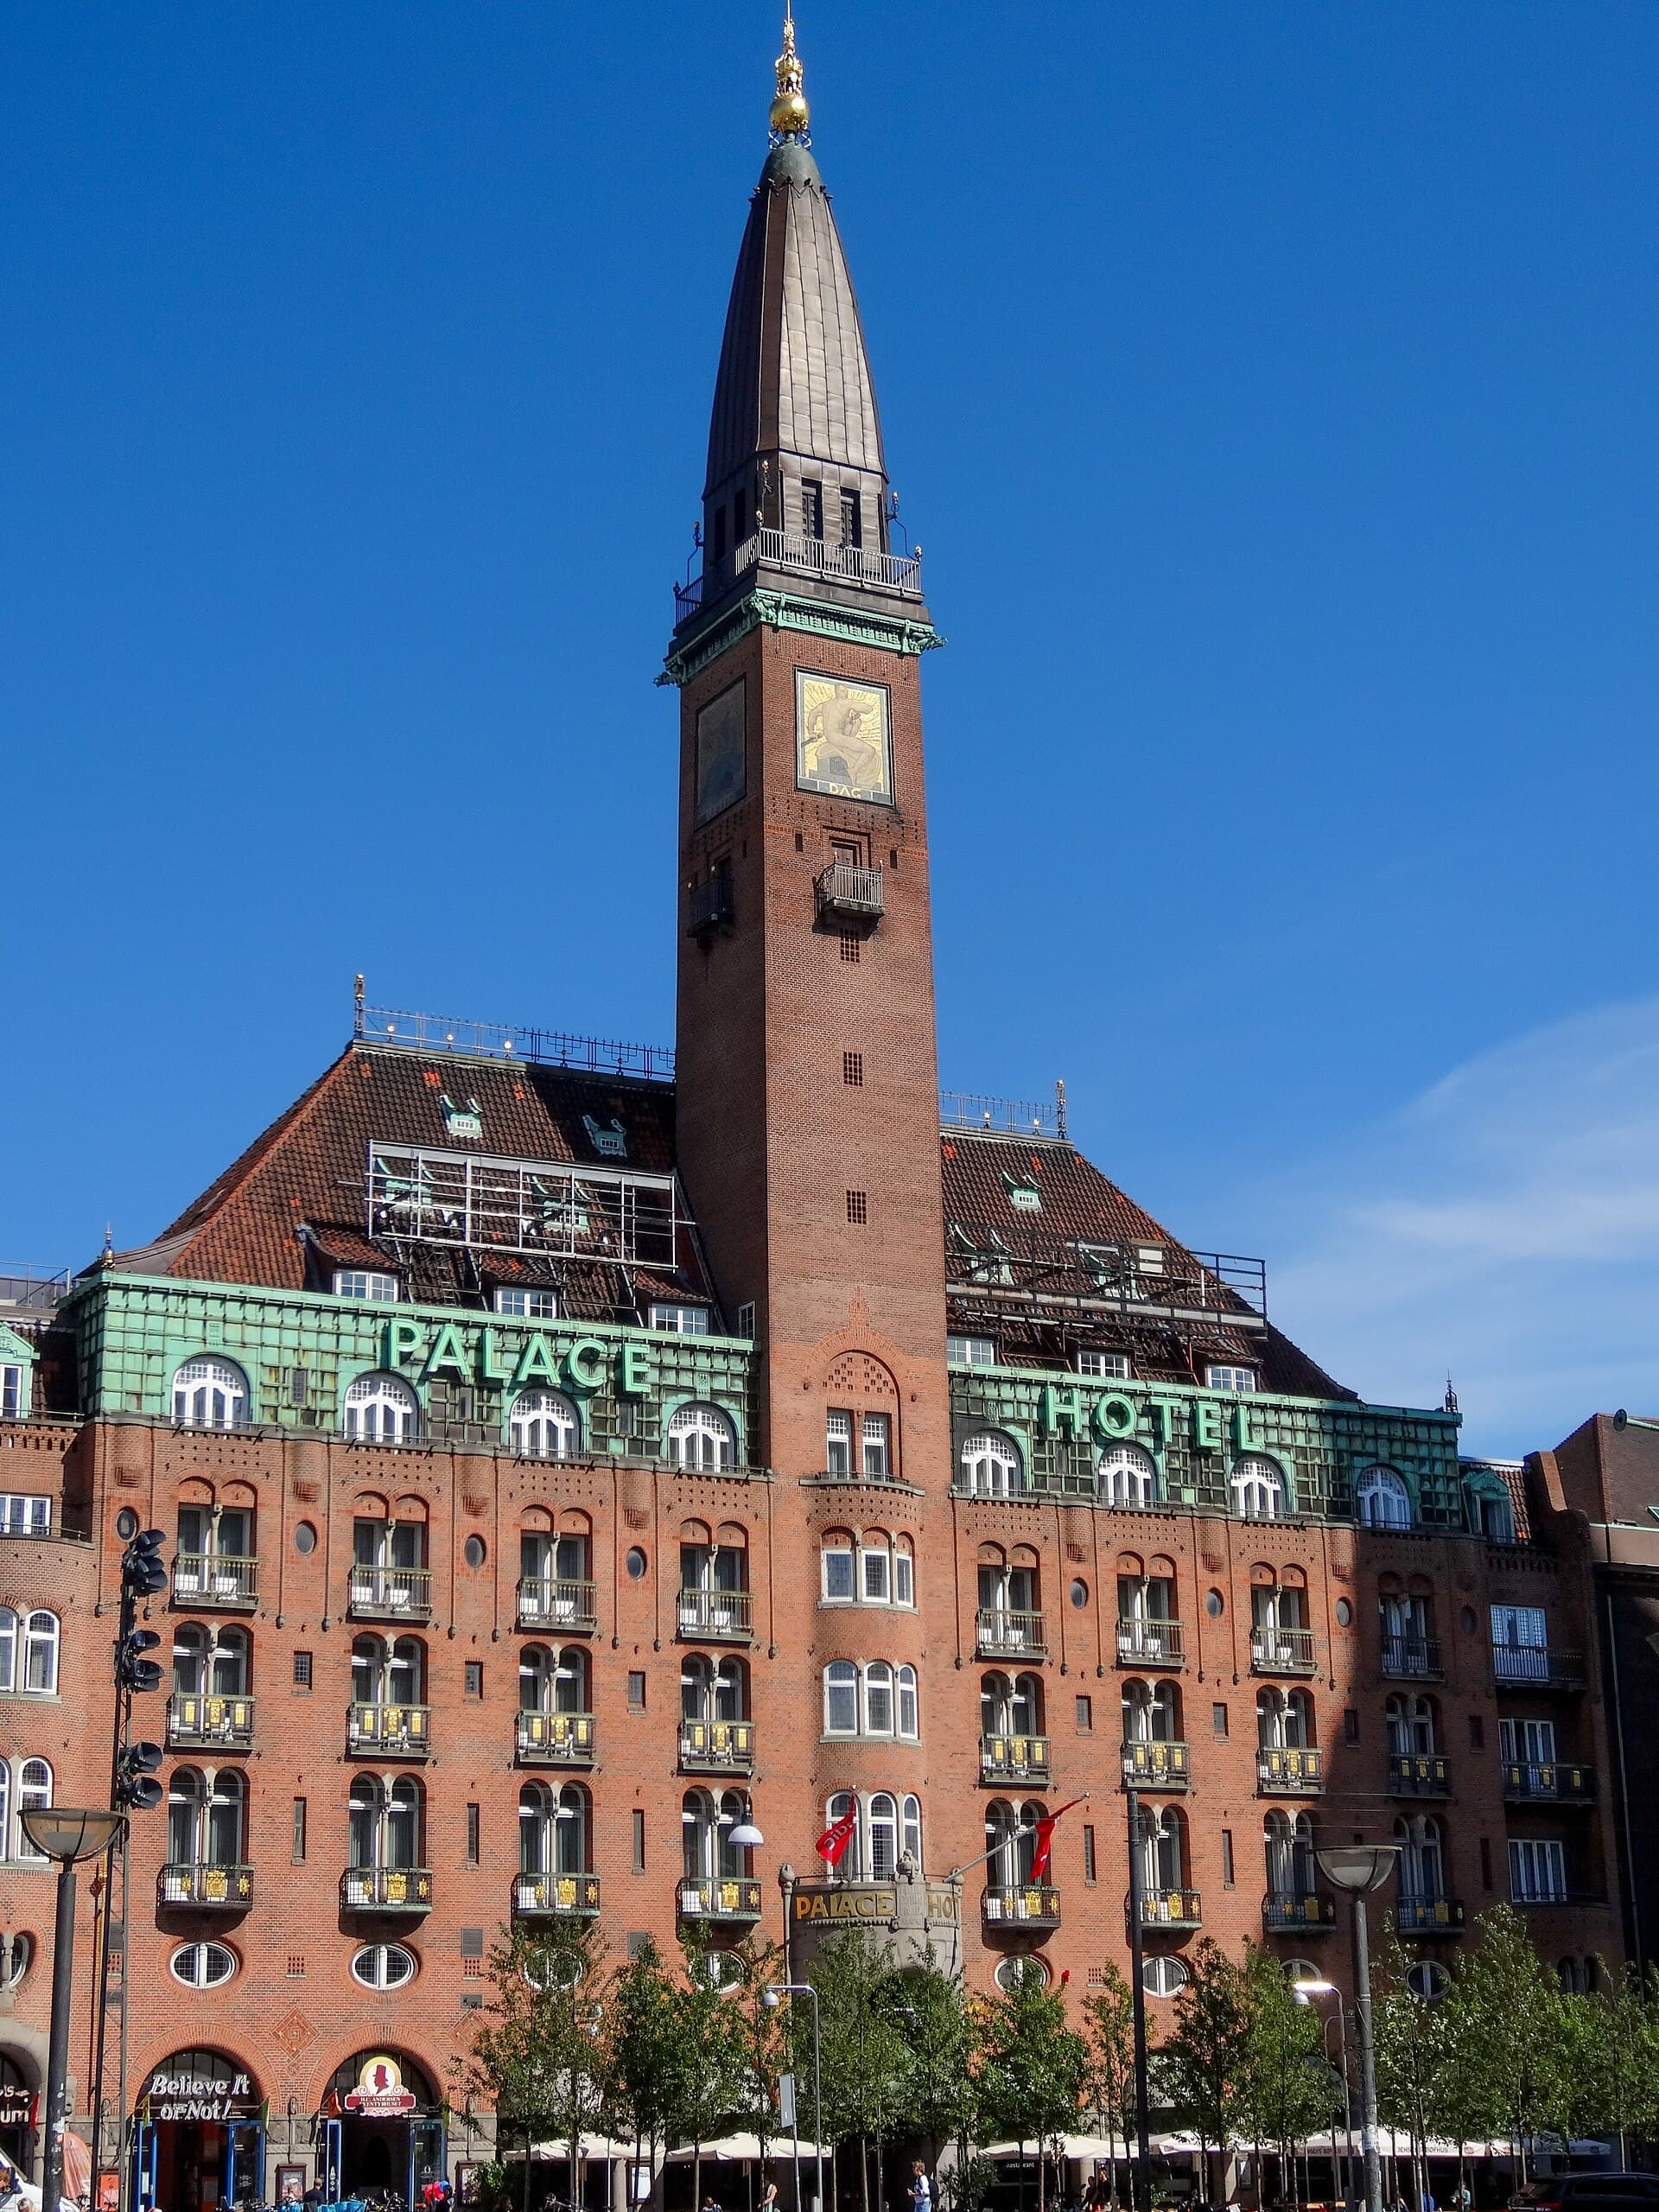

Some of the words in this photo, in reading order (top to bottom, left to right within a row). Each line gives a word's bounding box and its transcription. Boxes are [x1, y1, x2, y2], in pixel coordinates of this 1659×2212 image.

[830, 784, 861, 798] DAG
[388, 1319, 652, 1394] PALACE
[1045, 1385, 1264, 1452] HOTEL
[796, 1891, 894, 1920] PALACE
[149, 2075, 227, 2095] Believe
[232, 2074, 251, 2095] It
[185, 2099, 232, 2120] Not!
